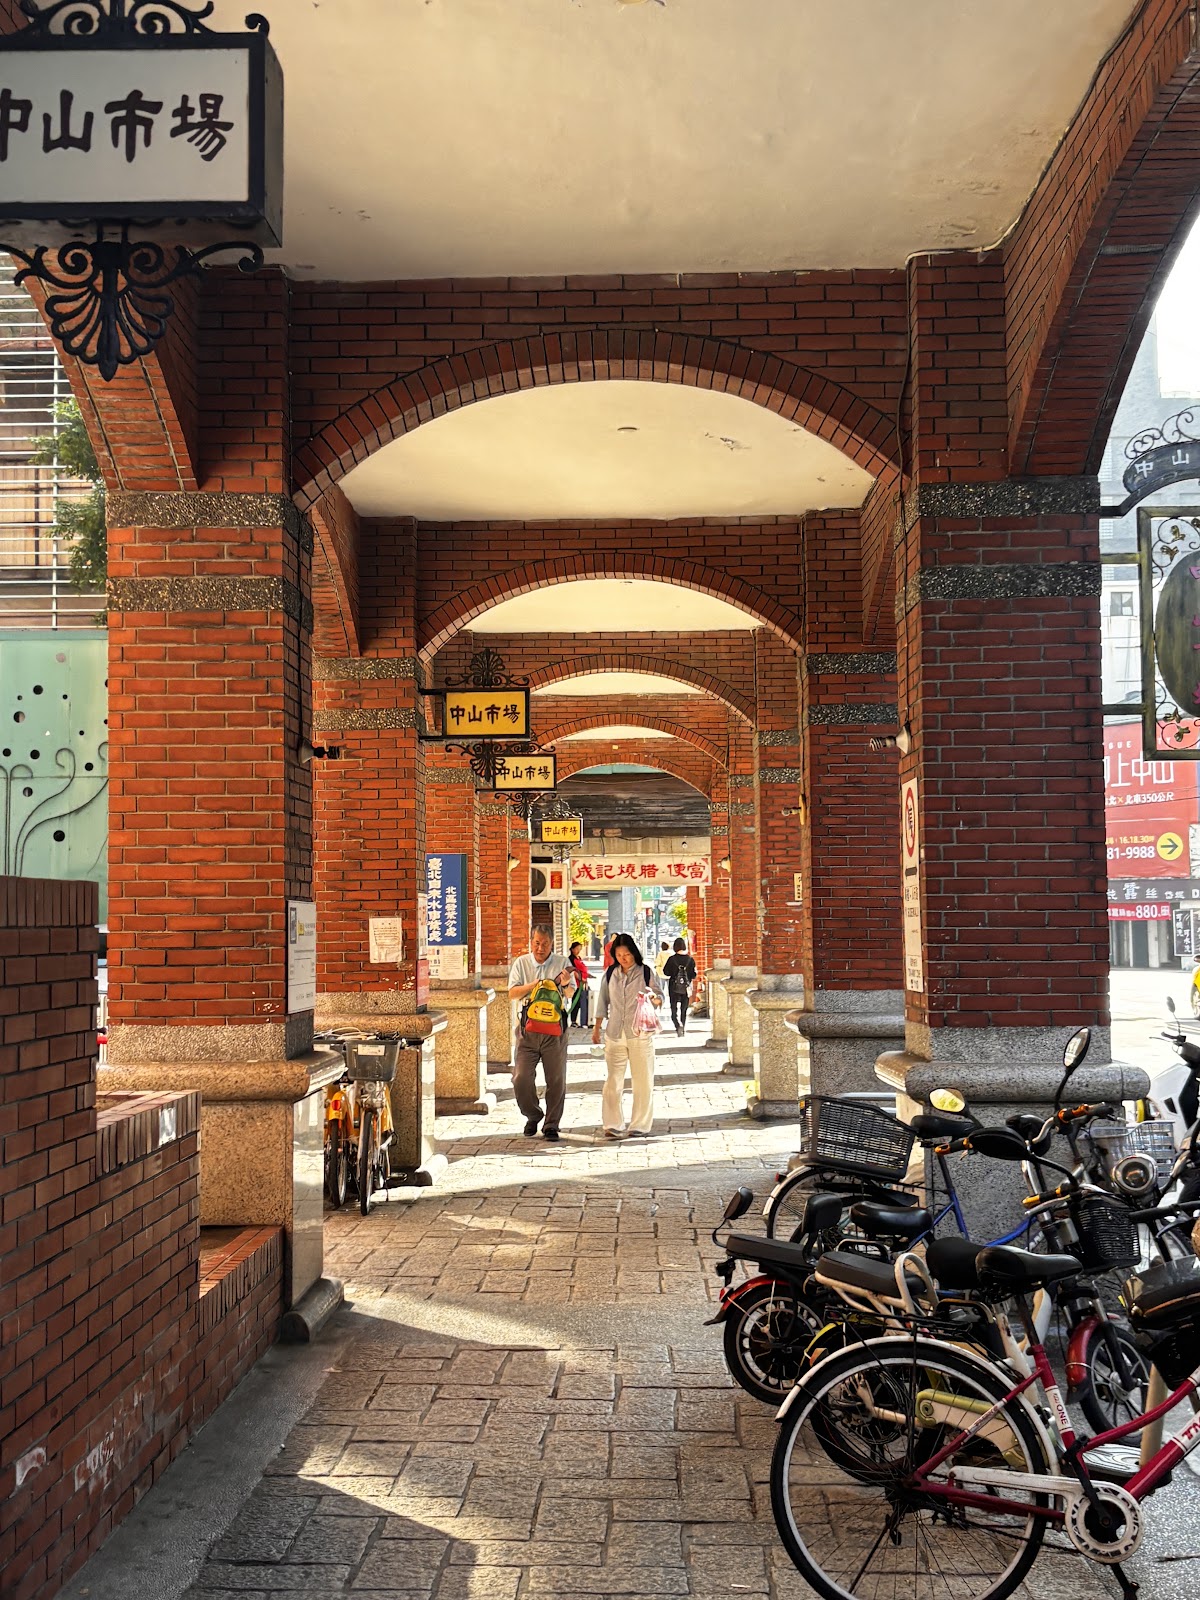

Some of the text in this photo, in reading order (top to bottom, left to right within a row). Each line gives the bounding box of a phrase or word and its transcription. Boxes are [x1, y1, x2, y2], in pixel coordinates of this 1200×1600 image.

[0, 88, 235, 163] 中山市場
[449, 703, 521, 726] 中山市場
[498, 765, 551, 781] 中山市場
[544, 825, 578, 836] 中山市場
[1106, 846, 1155, 860] 81-9988
[1056, 1404, 1069, 1425] ONE
